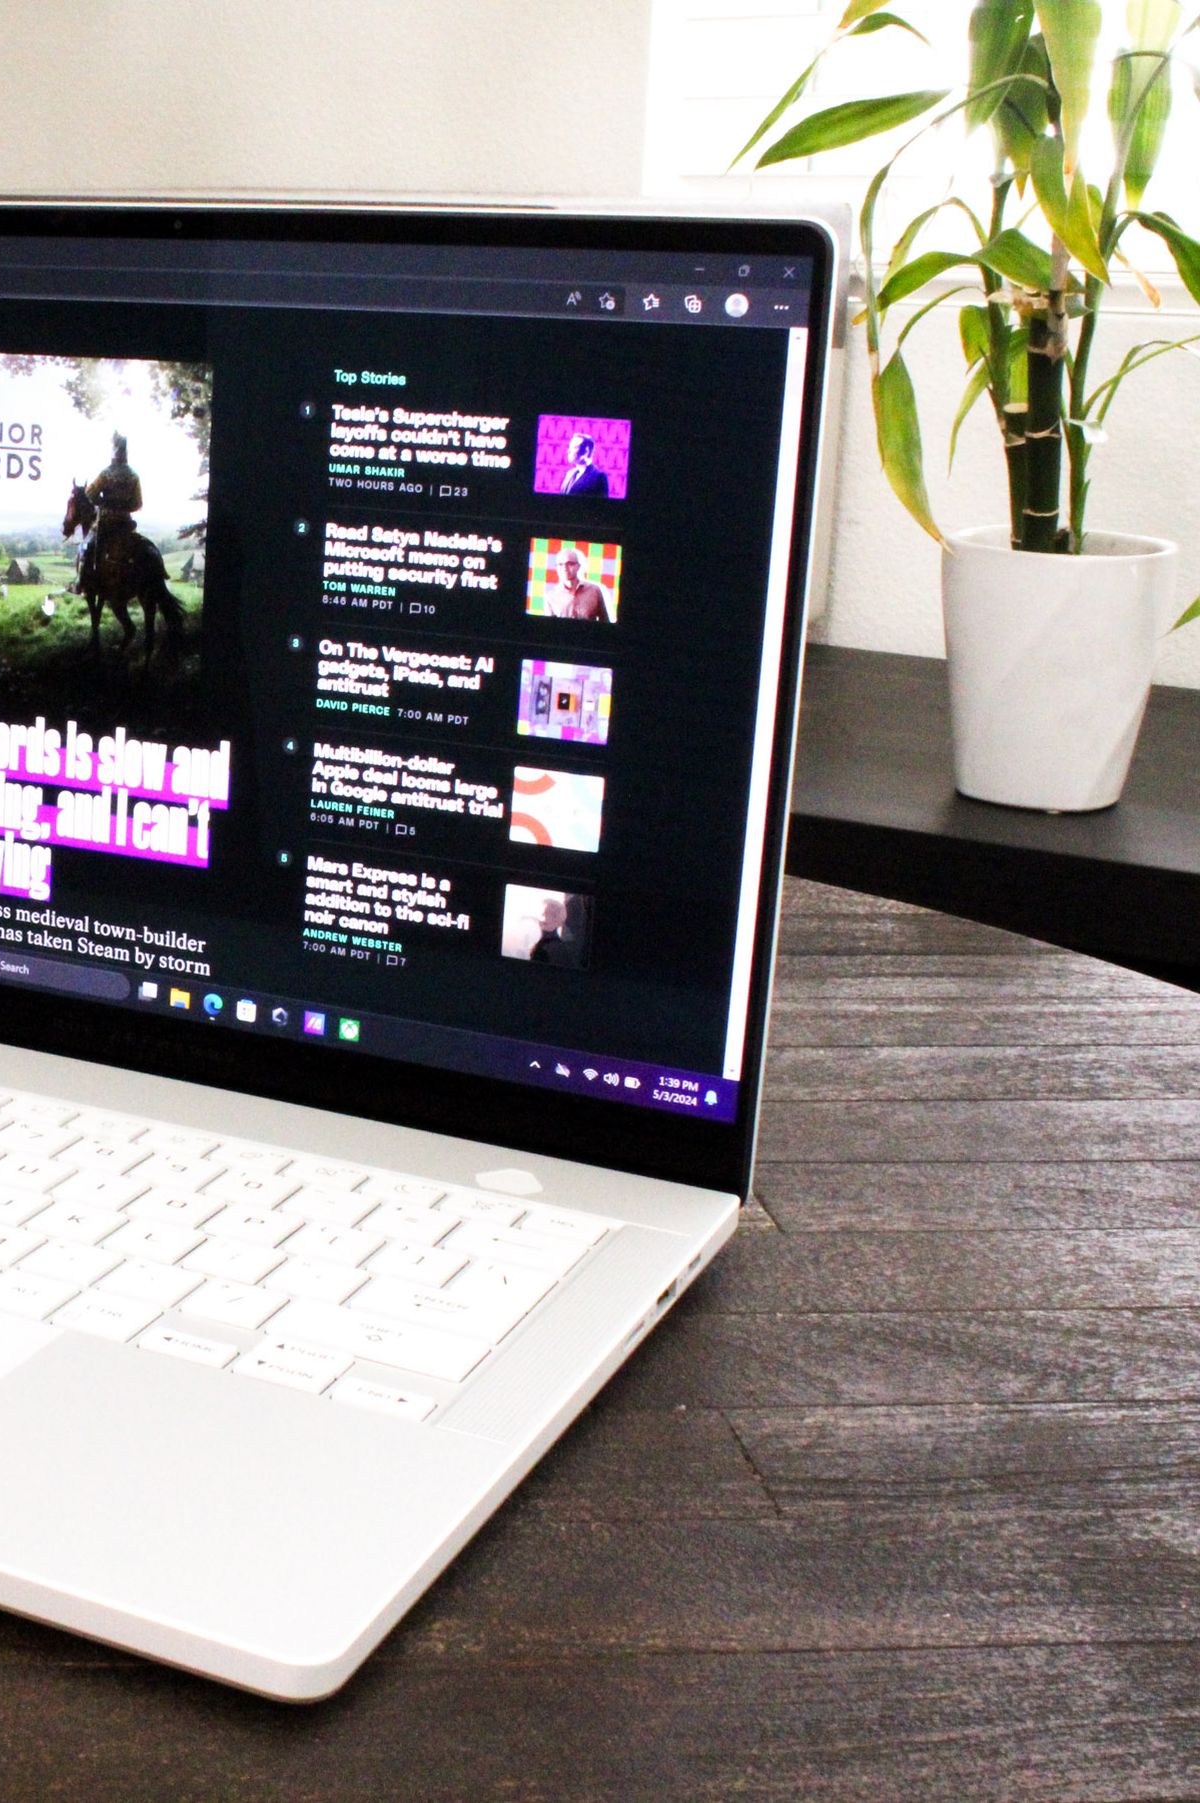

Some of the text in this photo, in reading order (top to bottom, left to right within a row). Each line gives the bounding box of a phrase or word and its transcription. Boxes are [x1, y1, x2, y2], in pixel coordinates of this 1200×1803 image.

[334, 369, 407, 386] Top Stories
[304, 406, 311, 415] 1
[331, 404, 510, 433] Tesla's Supercharger
[330, 423, 506, 449] layoffs couldn't have
[329, 444, 511, 469] come at a worse time
[329, 463, 405, 478] UMAR SHAKIR
[329, 478, 468, 497] TWO HOURS AGO 23
[298, 523, 306, 533] 2
[325, 522, 503, 553] Read Satya Nadella's
[325, 541, 486, 570] Microsoft memo on
[323, 561, 498, 590] putting security first
[322, 580, 396, 597] TOM WARREN
[351, 597, 368, 608] AM
[372, 600, 393, 611] PDT
[423, 604, 436, 615] 10
[292, 638, 300, 648] 3
[319, 639, 494, 673] On The Vergecast: AI
[317, 659, 480, 690] gadgets, iPads, and
[317, 676, 389, 697] antitrust
[316, 699, 469, 726] DAVID PIERCE 7:00 AM PDT
[286, 741, 294, 750] 4
[97, 726, 167, 791] slow
[171, 740, 230, 800] and
[314, 742, 455, 775] Multibillion-dollar
[312, 760, 498, 800] Apple deal looms large
[310, 799, 395, 819] LAUREN FEINER
[311, 778, 504, 819] in Google antitrust trial
[56, 785, 111, 844] and
[116, 788, 128, 846] I
[132, 798, 210, 859] can't
[338, 816, 354, 827] AM
[359, 819, 380, 831] PDT
[280, 853, 288, 862] 5
[306, 855, 451, 891] Mars Express is a
[306, 875, 446, 909] smart and stylish
[304, 892, 470, 930] addition to the sci-fi
[304, 908, 389, 935] noir canon
[15, 906, 89, 933] medieval
[93, 920, 206, 953] town-builder
[303, 928, 402, 952] ANDREW WEBSTER
[26, 928, 73, 950] taken
[77, 937, 130, 962] Steam
[134, 947, 156, 969] by
[159, 952, 211, 976] storm
[303, 941, 326, 953] 7:00
[330, 946, 346, 957] AM
[350, 949, 371, 960] PDT
[0, 960, 30, 975] Search
[658, 1076, 699, 1092] 1:39 PM
[652, 1089, 698, 1107] 5/3/2024
